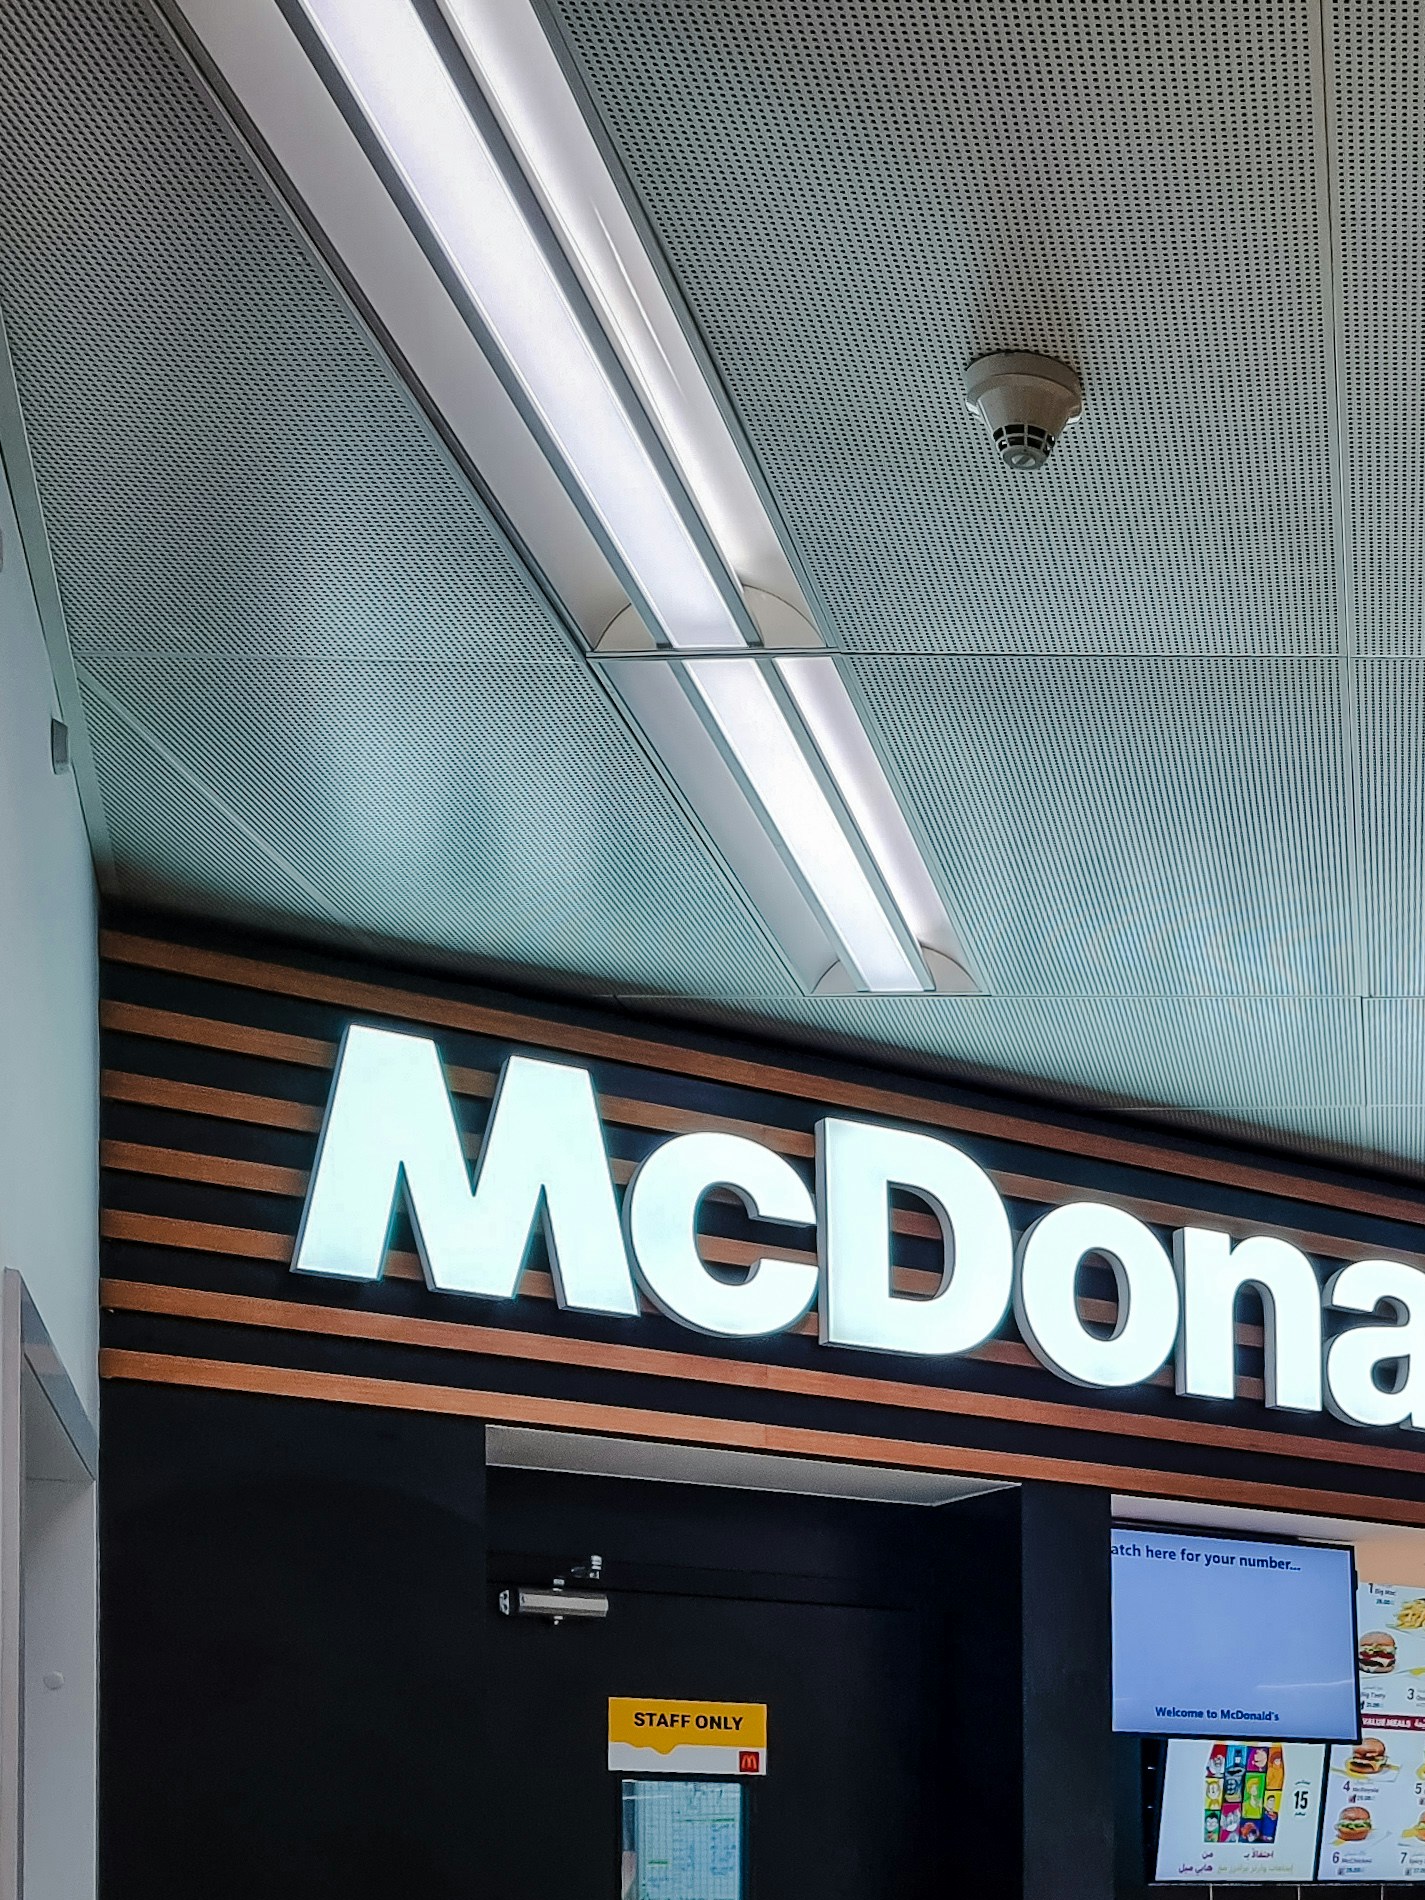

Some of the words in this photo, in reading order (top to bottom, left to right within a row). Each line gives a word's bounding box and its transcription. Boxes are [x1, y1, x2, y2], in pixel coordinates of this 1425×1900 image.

[1111, 1544, 1141, 1557] atch
[1145, 1545, 1176, 1560] here
[1181, 1548, 1201, 1562] for
[1204, 1553, 1235, 1566] your
[1239, 1556, 1301, 1571] number...
[1407, 1688, 1415, 1700] 3
[1155, 1706, 1204, 1718] Welcome
[1207, 1709, 1217, 1719] to
[1220, 1709, 1280, 1722] McDonald's
[633, 1712, 691, 1728] STAFF
[695, 1714, 744, 1731] ONLY
[1343, 1781, 1350, 1792] 4
[1415, 1783, 1422, 1795] 5
[1294, 1790, 1309, 1810] 15
[1332, 1852, 1340, 1864] 6
[1400, 1852, 1407, 1864] 7
